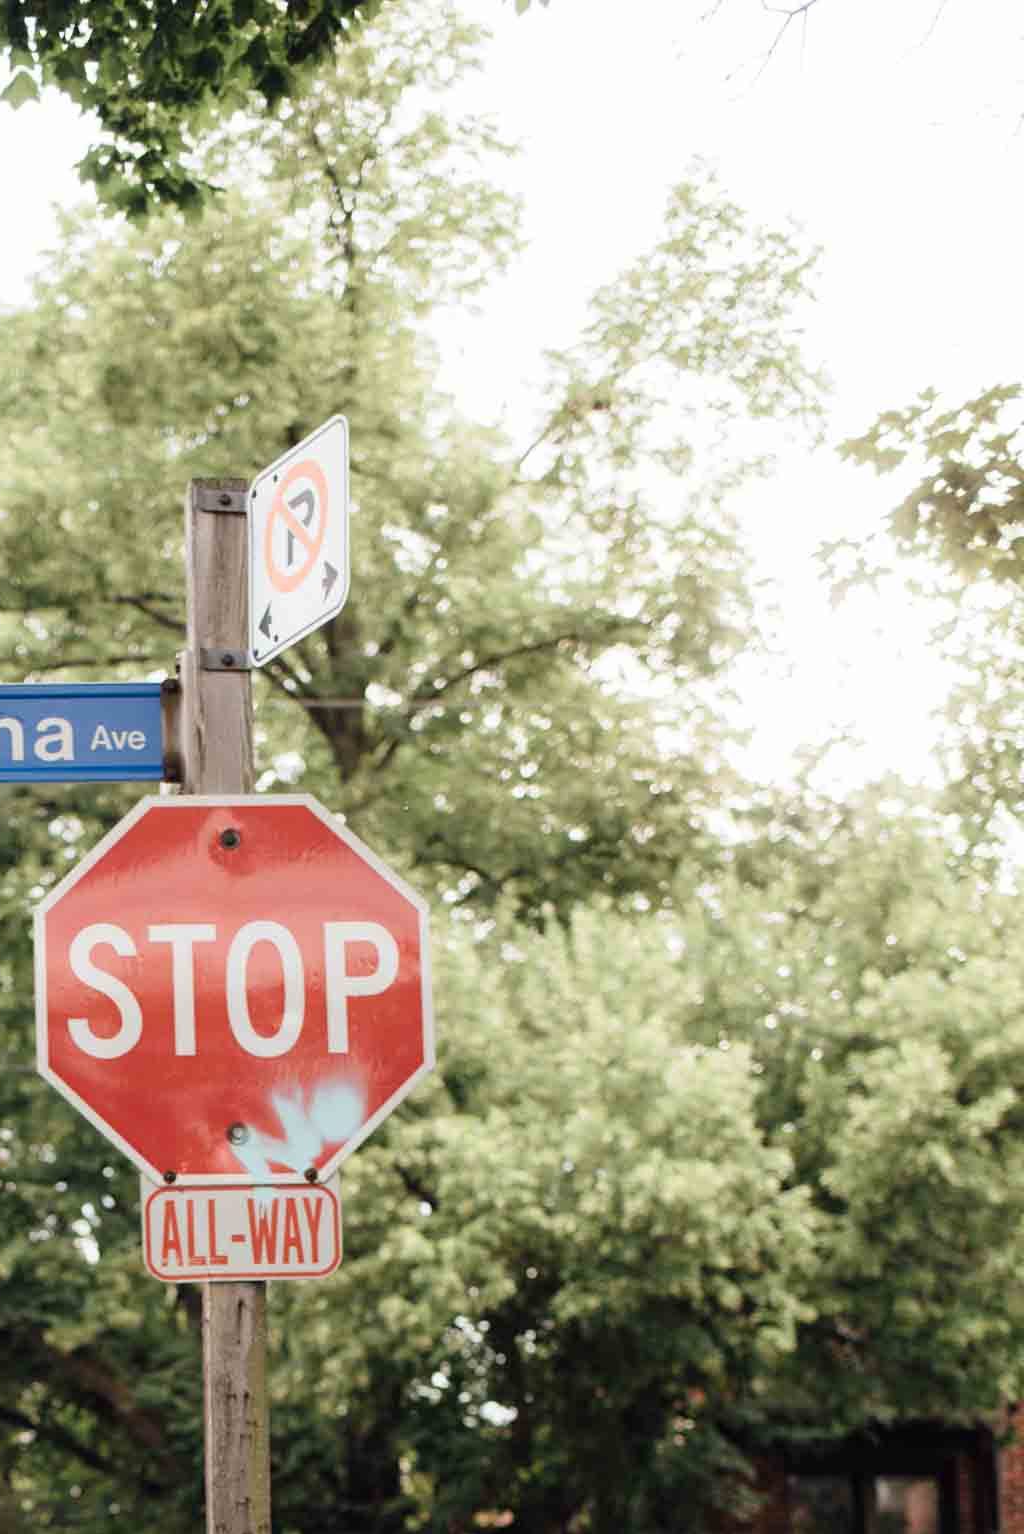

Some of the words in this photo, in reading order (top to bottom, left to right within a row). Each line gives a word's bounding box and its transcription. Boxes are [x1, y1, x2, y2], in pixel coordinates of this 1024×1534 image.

[90, 724, 147, 751] Ave
[66, 919, 401, 1060] STOP
[160, 1196, 324, 1267] ALL-WAY
